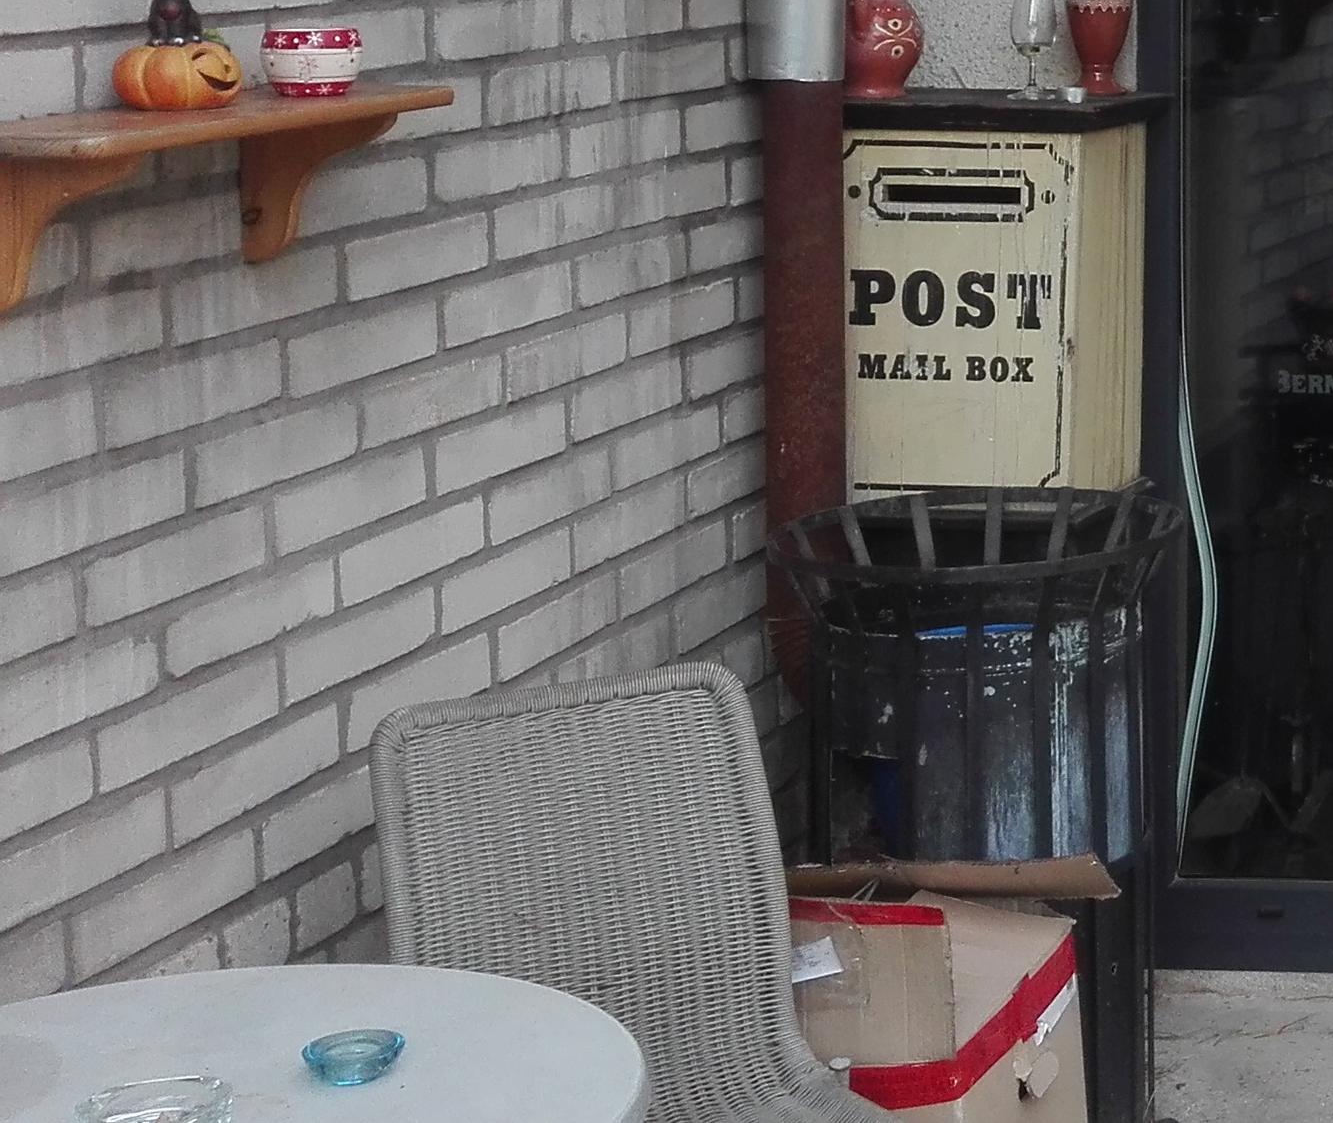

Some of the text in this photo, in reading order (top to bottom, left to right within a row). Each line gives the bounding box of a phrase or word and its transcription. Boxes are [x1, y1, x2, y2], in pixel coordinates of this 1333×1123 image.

[849, 268, 1052, 330] POST
[858, 353, 1034, 383] MAIL BOX
